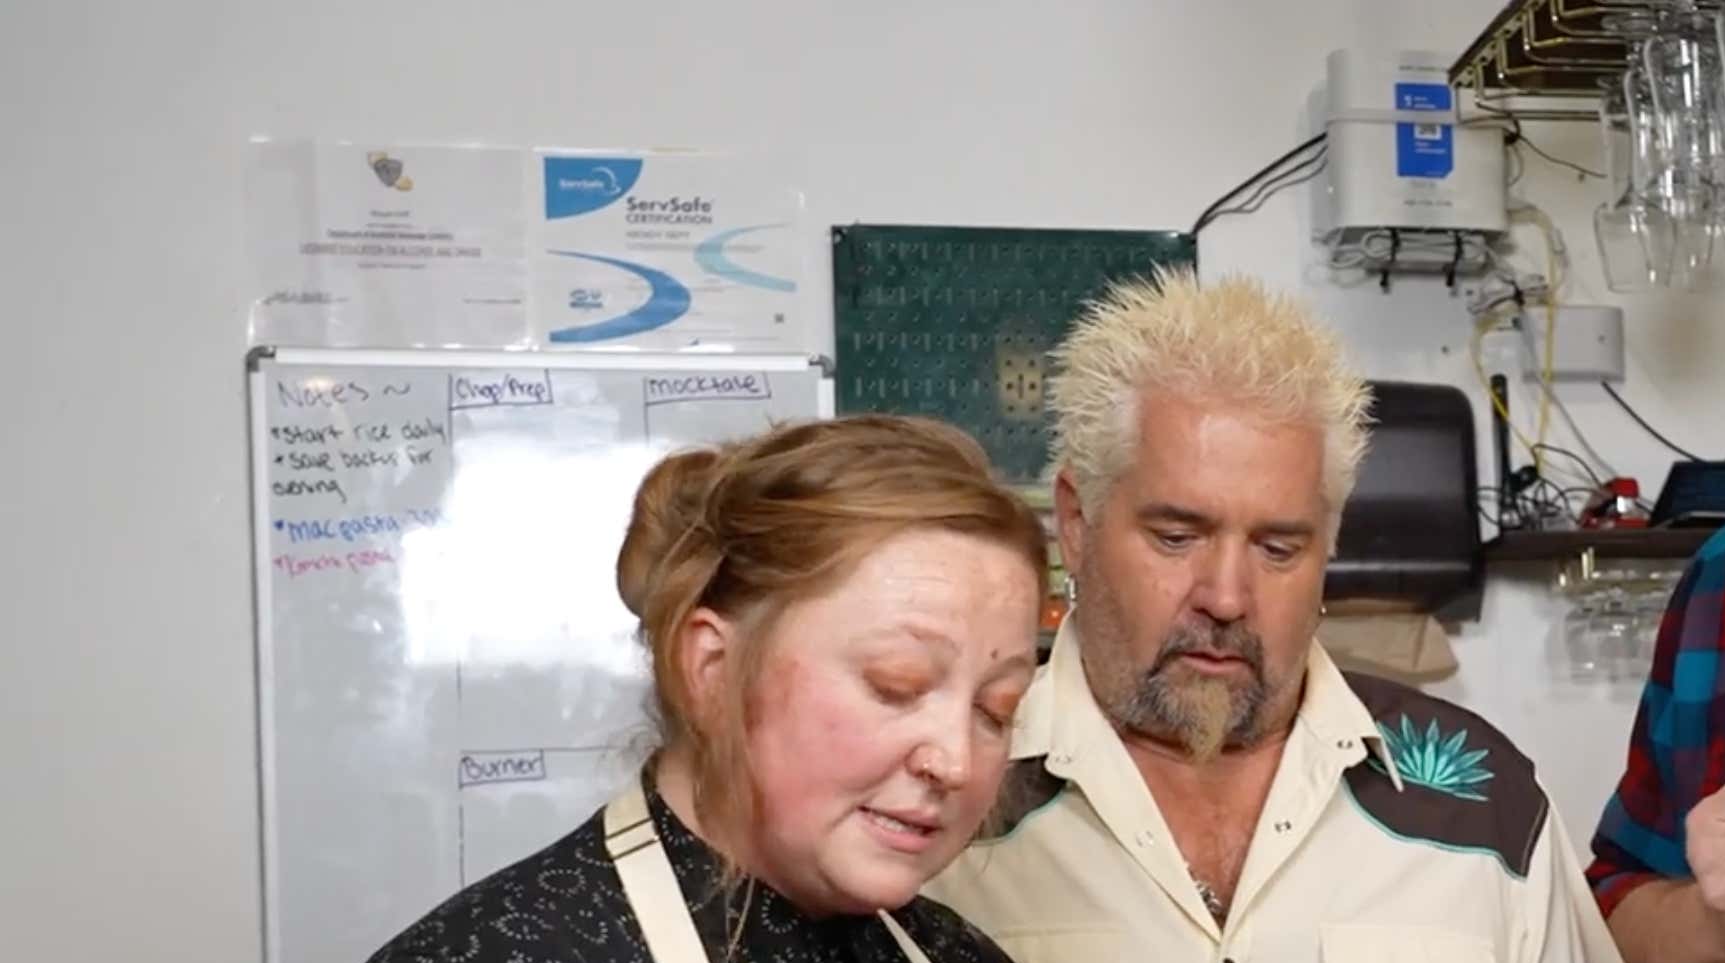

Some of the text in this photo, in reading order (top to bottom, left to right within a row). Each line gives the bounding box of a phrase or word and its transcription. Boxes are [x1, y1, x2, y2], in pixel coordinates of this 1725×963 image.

[626, 197, 712, 213] ServSafe
[625, 214, 713, 225] CERTIFICATION
[278, 381, 369, 408] Notes
[462, 756, 538, 779] Burner
